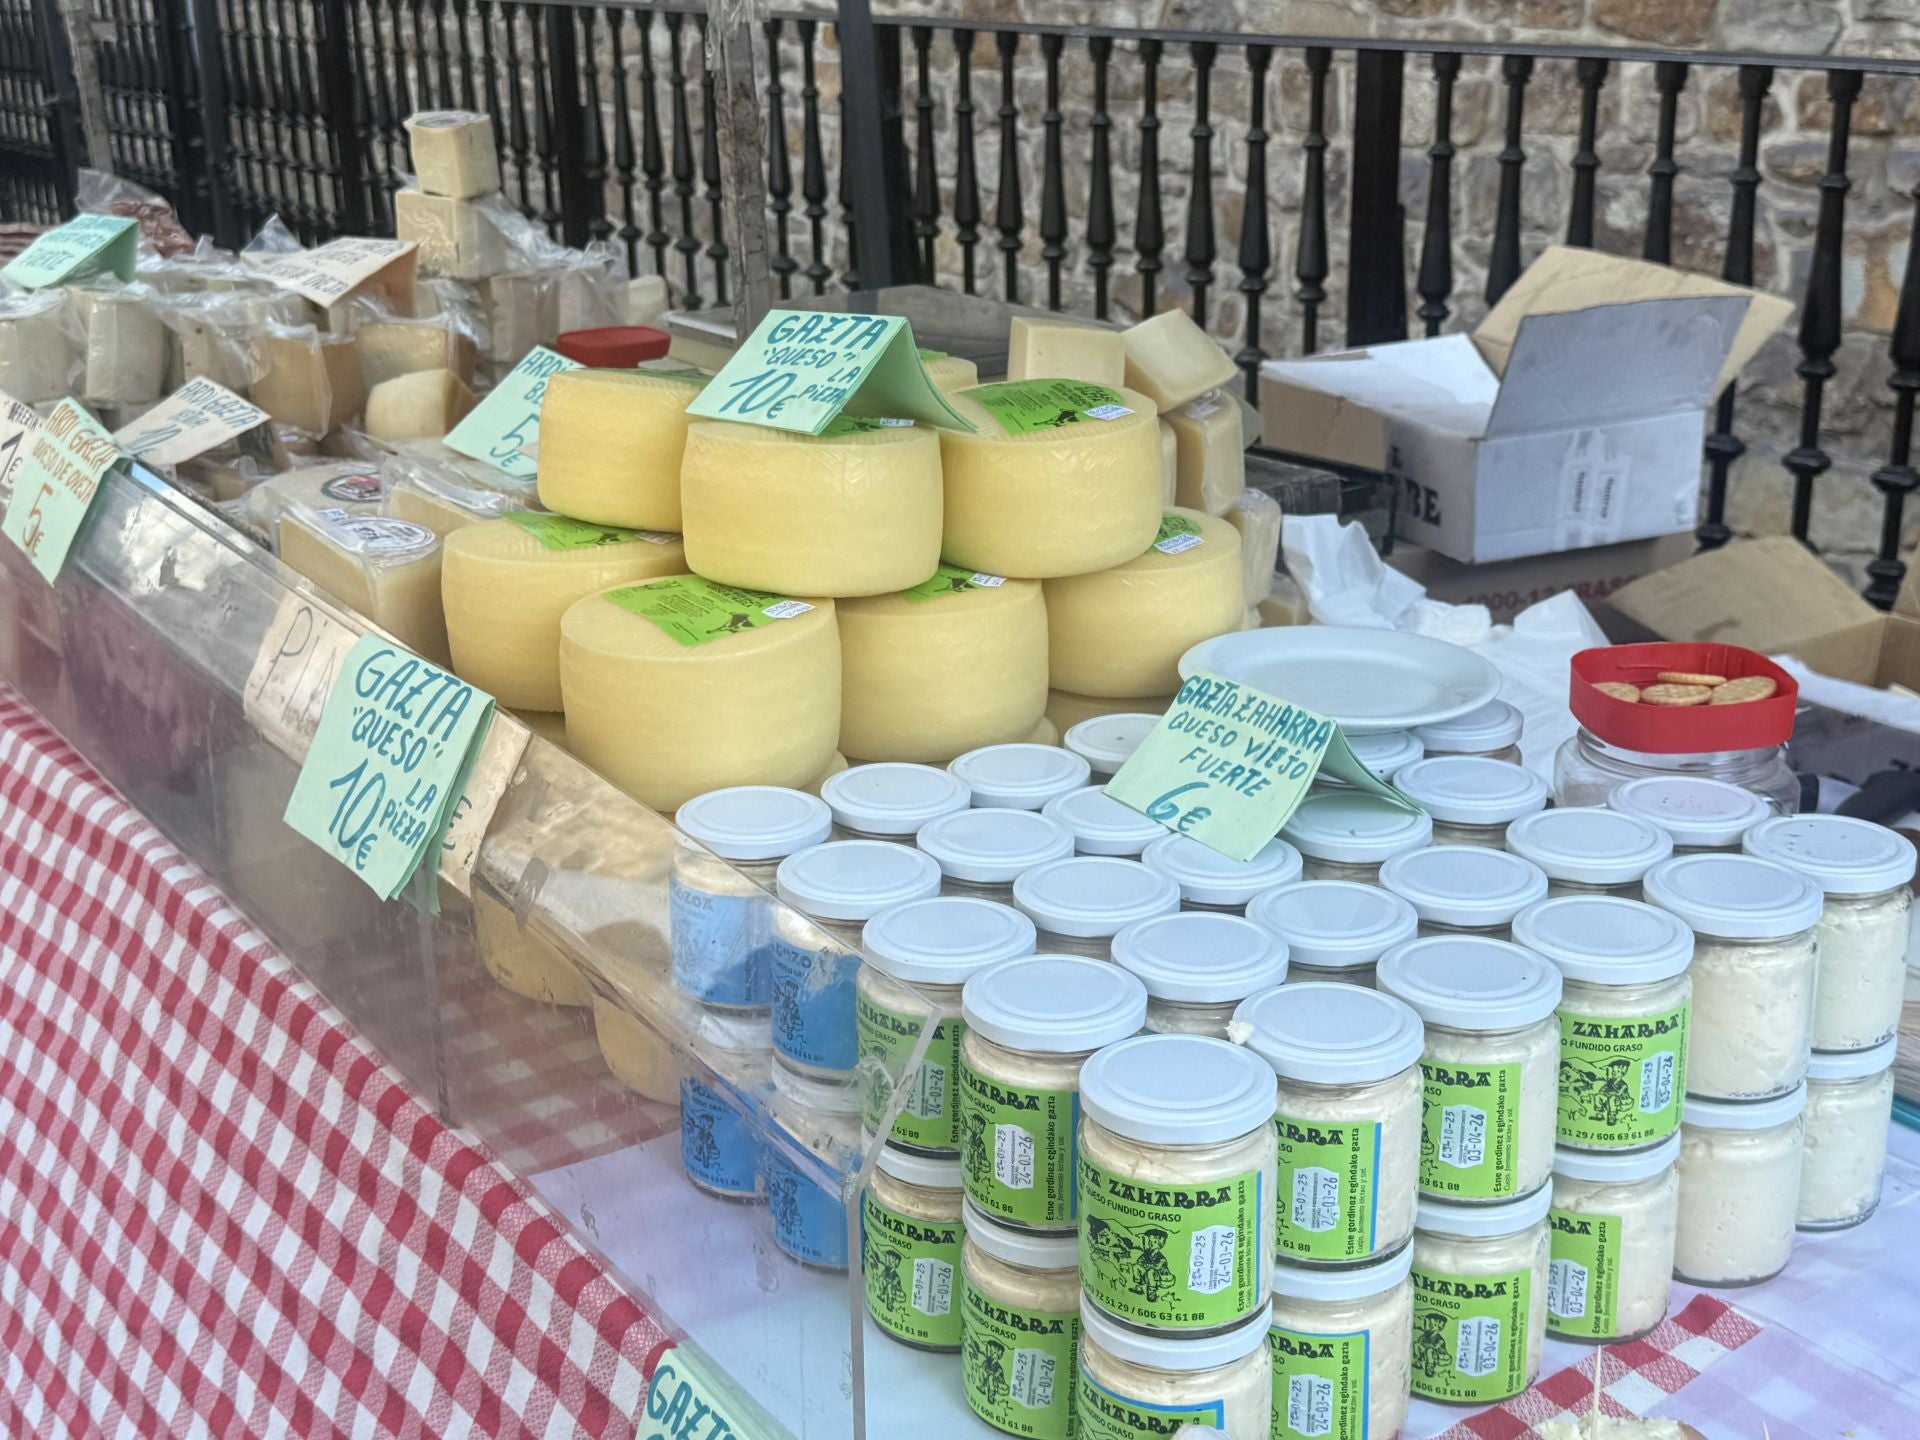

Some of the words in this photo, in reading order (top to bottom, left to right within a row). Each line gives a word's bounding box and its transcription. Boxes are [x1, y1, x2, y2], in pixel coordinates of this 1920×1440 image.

[767, 314, 889, 350] GAZTA
[828, 366, 861, 384] LA
[355, 650, 473, 741] GAZTA
[1167, 711, 1238, 748] QUESO
[1176, 675, 1241, 719] GAZTA
[1231, 696, 1331, 754] ZAHARRA
[1178, 746, 1272, 797] FUERTE
[406, 778, 437, 813] LA
[1146, 782, 1212, 832] 6€
[1573, 1014, 1679, 1039] ZAHARRA
[1569, 1040, 1611, 1052] FUNDIDO
[1613, 1043, 1643, 1053] GRASO
[1048, 1096, 1057, 1120] gazta
[1496, 1095, 1506, 1133] egindako
[1047, 1121, 1056, 1161] egindako
[1350, 1127, 1360, 1152] gazta
[1468, 1113, 1485, 1162] 03-04-26
[1495, 1134, 1504, 1171] gordinez
[1575, 1130, 1588, 1139] 29
[1596, 1132, 1615, 1141] 606
[1617, 1131, 1629, 1141] 63
[1631, 1130, 1641, 1139] 61
[1019, 1135, 1033, 1185] 24-03-26
[1348, 1154, 1359, 1194] egindako
[1046, 1162, 1056, 1200] gordinez
[1108, 1178, 1231, 1210] ZAHARRA
[1432, 1179, 1444, 1189] 61
[1494, 1173, 1502, 1192] Esne
[868, 1199, 956, 1244] ZAHARRA
[1046, 1201, 1055, 1221] Esne
[1107, 1199, 1146, 1218] FUNDIDO
[1147, 1210, 1182, 1223] GRASO
[1237, 1208, 1246, 1248] egindako
[1347, 1196, 1357, 1233] gordinez
[1218, 1231, 1235, 1287] 24-03-26
[1283, 1240, 1294, 1249] 61
[1346, 1235, 1355, 1255] Esne
[1237, 1251, 1246, 1289] gordinez
[936, 1267, 952, 1312] 24-03-26
[1237, 1291, 1245, 1312] Esne
[1430, 1297, 1461, 1310] GRASO
[1570, 1269, 1586, 1314] 03-04-26
[967, 1286, 1064, 1335] ZAHARRA
[1105, 1296, 1115, 1307] 51
[1117, 1300, 1129, 1313] 29
[1137, 1307, 1157, 1320] 606
[1159, 1311, 1172, 1321] 63
[1175, 1312, 1188, 1322] 61
[905, 1325, 915, 1336] 61
[990, 1325, 1017, 1341] GRASO
[1483, 1323, 1499, 1369] 03-04-26
[1341, 1341, 1350, 1365] gazta
[1036, 1358, 1056, 1405] 24-03-26
[1340, 1366, 1350, 1404] egindako
[1416, 1380, 1433, 1392] 606
[1435, 1385, 1448, 1396] 63
[1450, 1388, 1462, 1397] 61
[647, 1365, 742, 1440] GAZT
[1315, 1383, 1331, 1431] 24-03-26
[996, 1414, 1006, 1425] 63
[1008, 1419, 1019, 1430] 61
[1107, 1422, 1135, 1440] GRASO
